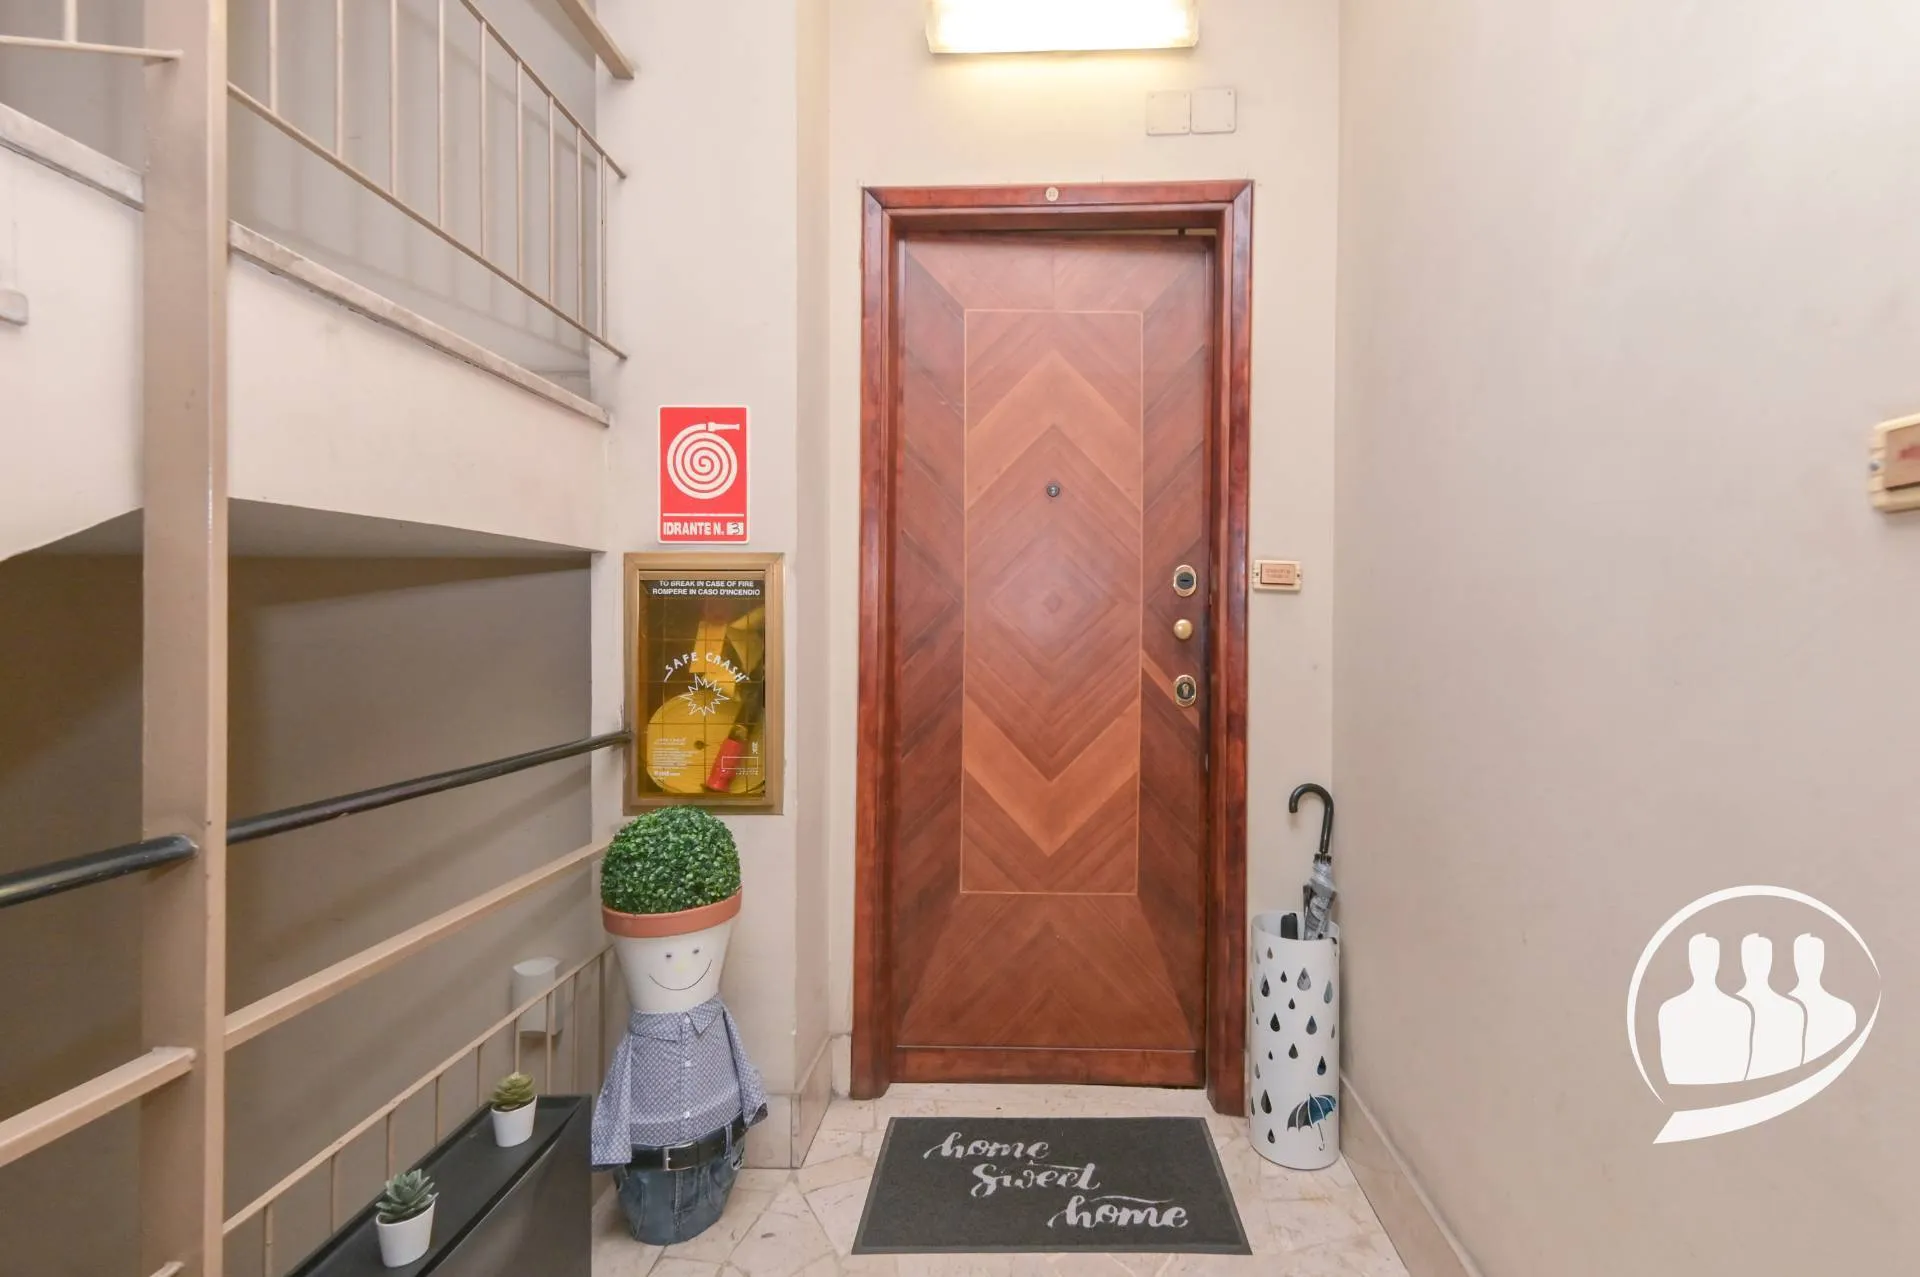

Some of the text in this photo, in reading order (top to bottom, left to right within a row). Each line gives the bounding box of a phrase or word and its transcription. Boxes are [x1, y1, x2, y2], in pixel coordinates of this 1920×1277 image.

[663, 521, 711, 536] IDRANTE
[713, 521, 725, 536] N.
[720, 588, 761, 596] D'INCENDIO
[663, 651, 746, 683] SAFE CRASH
[923, 1131, 1050, 1159] home
[1046, 1194, 1189, 1228] home
